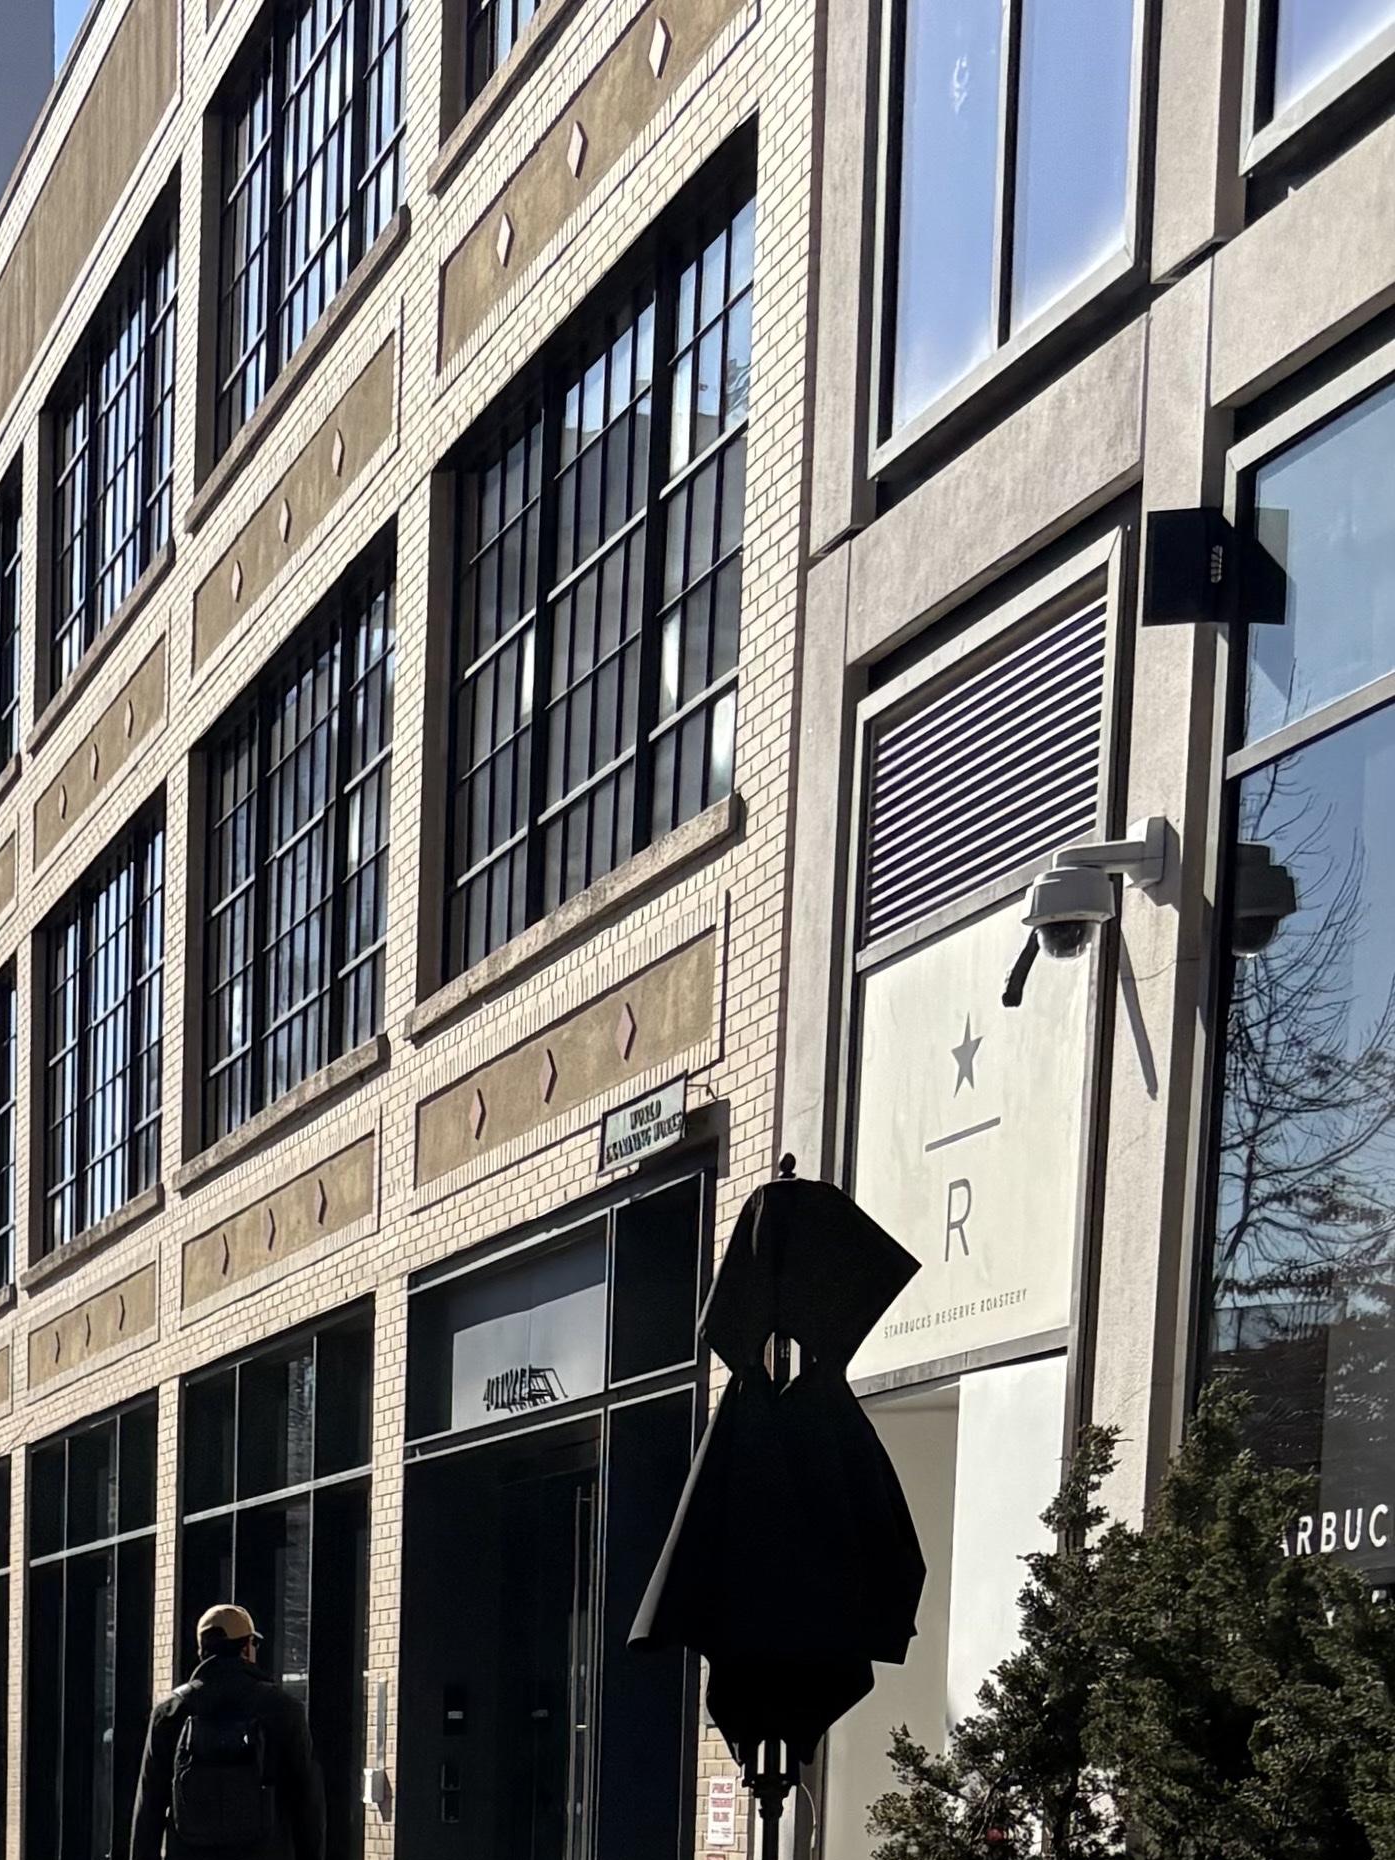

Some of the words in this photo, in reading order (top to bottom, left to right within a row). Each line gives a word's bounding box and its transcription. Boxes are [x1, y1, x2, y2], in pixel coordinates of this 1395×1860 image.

[944, 1178, 972, 1262] R
[884, 1314, 932, 1339] STARBUCKS
[934, 1302, 976, 1325] RESERVE
[980, 1287, 1028, 1313] ROASTERY
